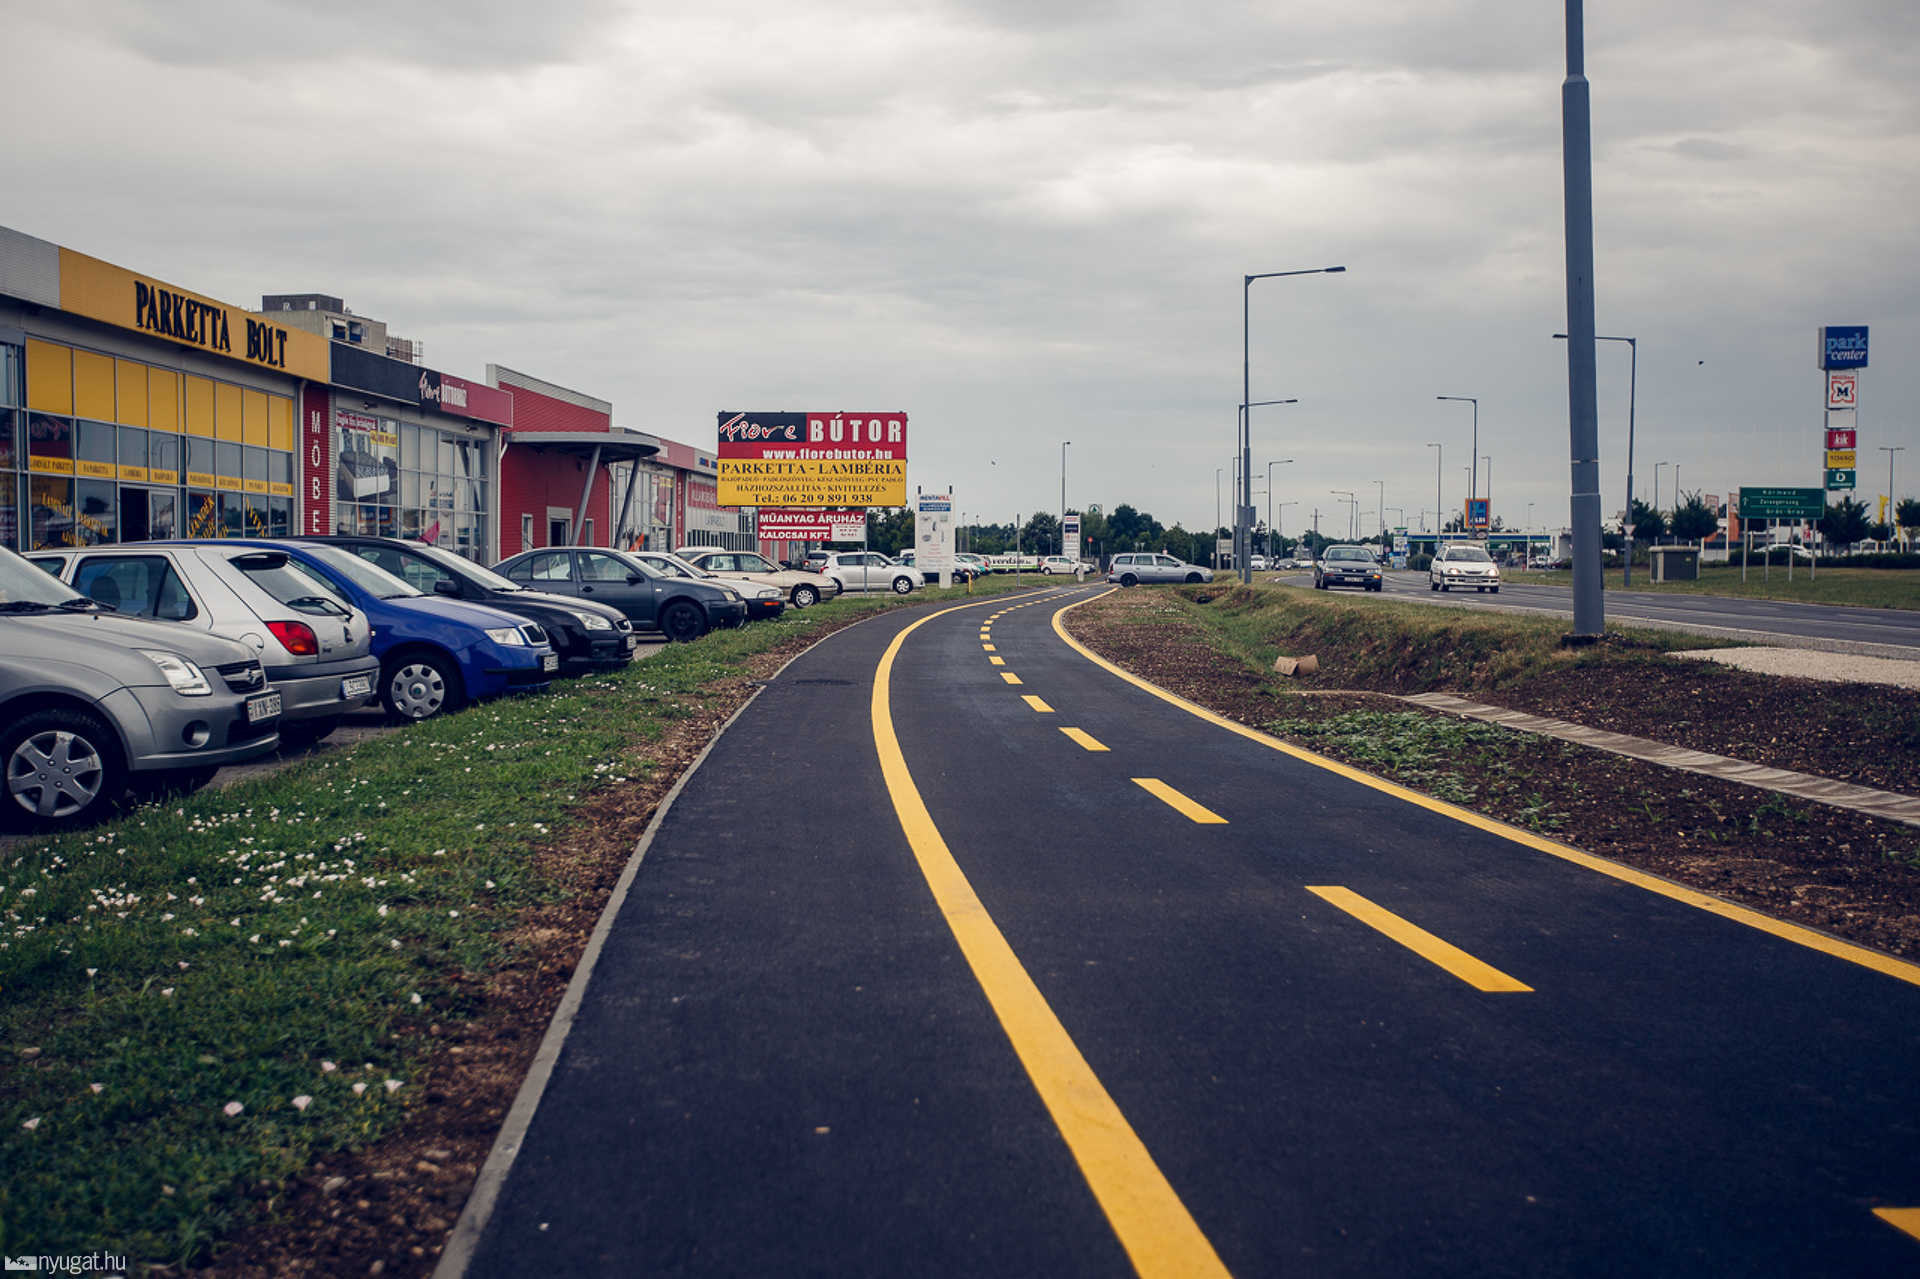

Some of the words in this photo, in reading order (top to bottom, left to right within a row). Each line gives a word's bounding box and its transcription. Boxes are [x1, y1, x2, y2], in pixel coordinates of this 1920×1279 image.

[134, 280, 231, 352] PARKETTA
[245, 318, 287, 368] BOLT
[1826, 332, 1866, 355] park
[1831, 351, 1866, 360] center
[1837, 387, 1848, 396] M
[720, 413, 798, 442] Fiore
[810, 414, 902, 442] BÚTOR
[762, 449, 893, 460] www.fiorebutor.hu
[721, 463, 806, 475] PARKETTA
[819, 460, 902, 475] LAMBÉRIA
[753, 494, 779, 503] Tel.:
[783, 494, 797, 503] 06
[801, 494, 814, 503] 20
[817, 494, 825, 503] 9
[828, 494, 850, 503] 891
[852, 494, 873, 503] 938
[760, 513, 815, 523] MŰANYAG
[817, 512, 864, 523] ÁRUHÁZ
[760, 531, 808, 539] KALOCSAI
[809, 531, 830, 539] KFT.
